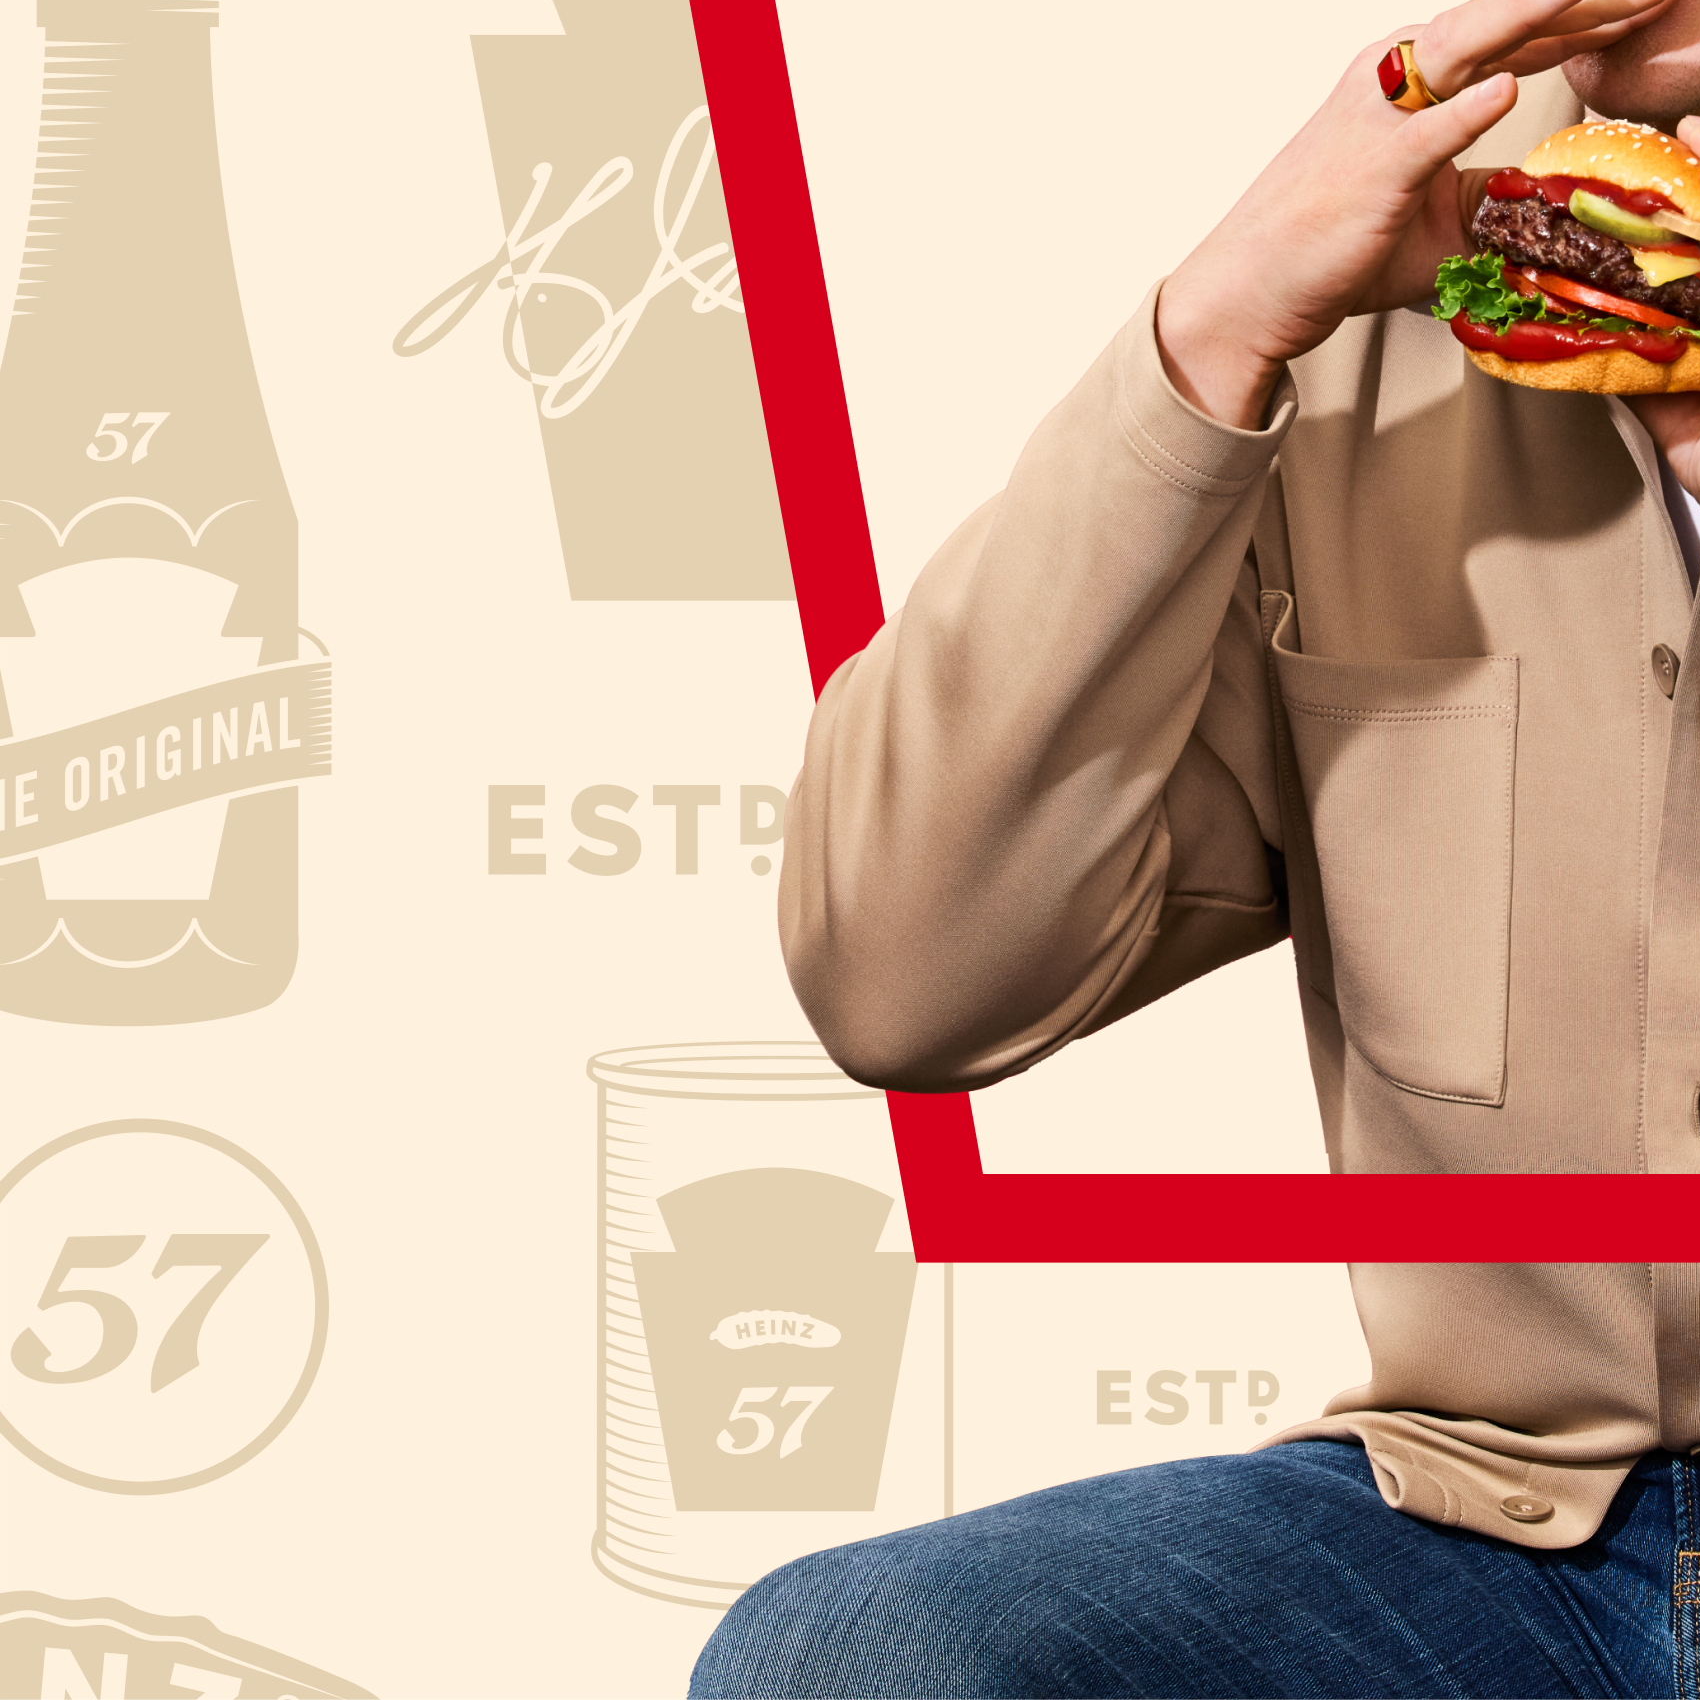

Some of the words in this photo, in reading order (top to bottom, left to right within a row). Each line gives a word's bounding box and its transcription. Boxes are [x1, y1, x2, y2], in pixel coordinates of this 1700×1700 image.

[86, 413, 170, 464] 57
[65, 697, 300, 811] ORIGINAL
[11, 1234, 270, 1393] 57
[736, 1320, 814, 1339] HEINZ
[717, 1387, 834, 1458] 57
